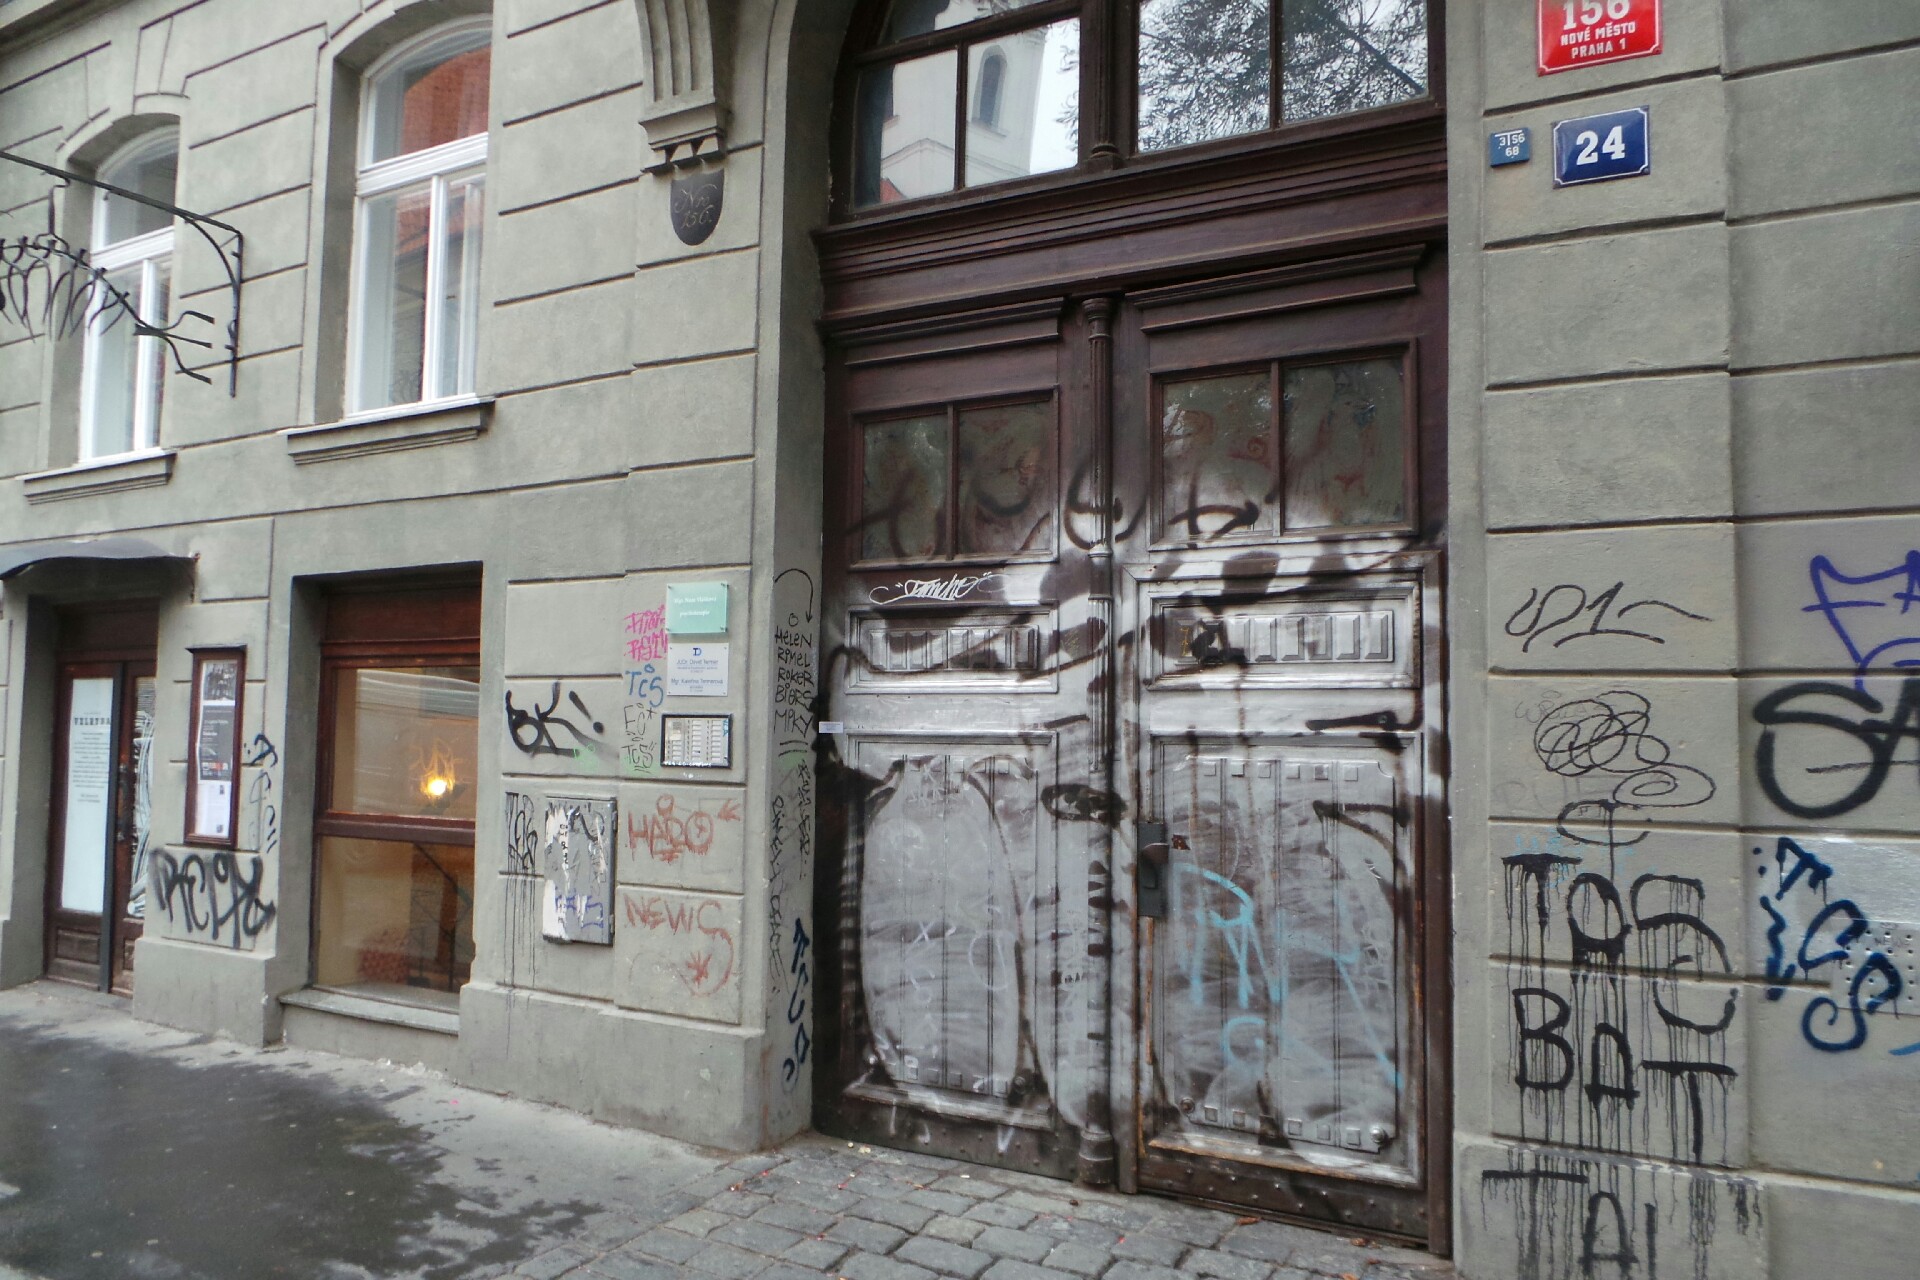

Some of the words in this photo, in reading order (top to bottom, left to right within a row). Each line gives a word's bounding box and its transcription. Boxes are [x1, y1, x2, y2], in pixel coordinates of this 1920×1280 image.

[1561, 26, 1591, 46] NOVÉ
[1595, 21, 1636, 40] MĚSTO
[1571, 40, 1613, 59] PRAHA
[1619, 37, 1626, 50] 1
[1576, 126, 1626, 165] 24
